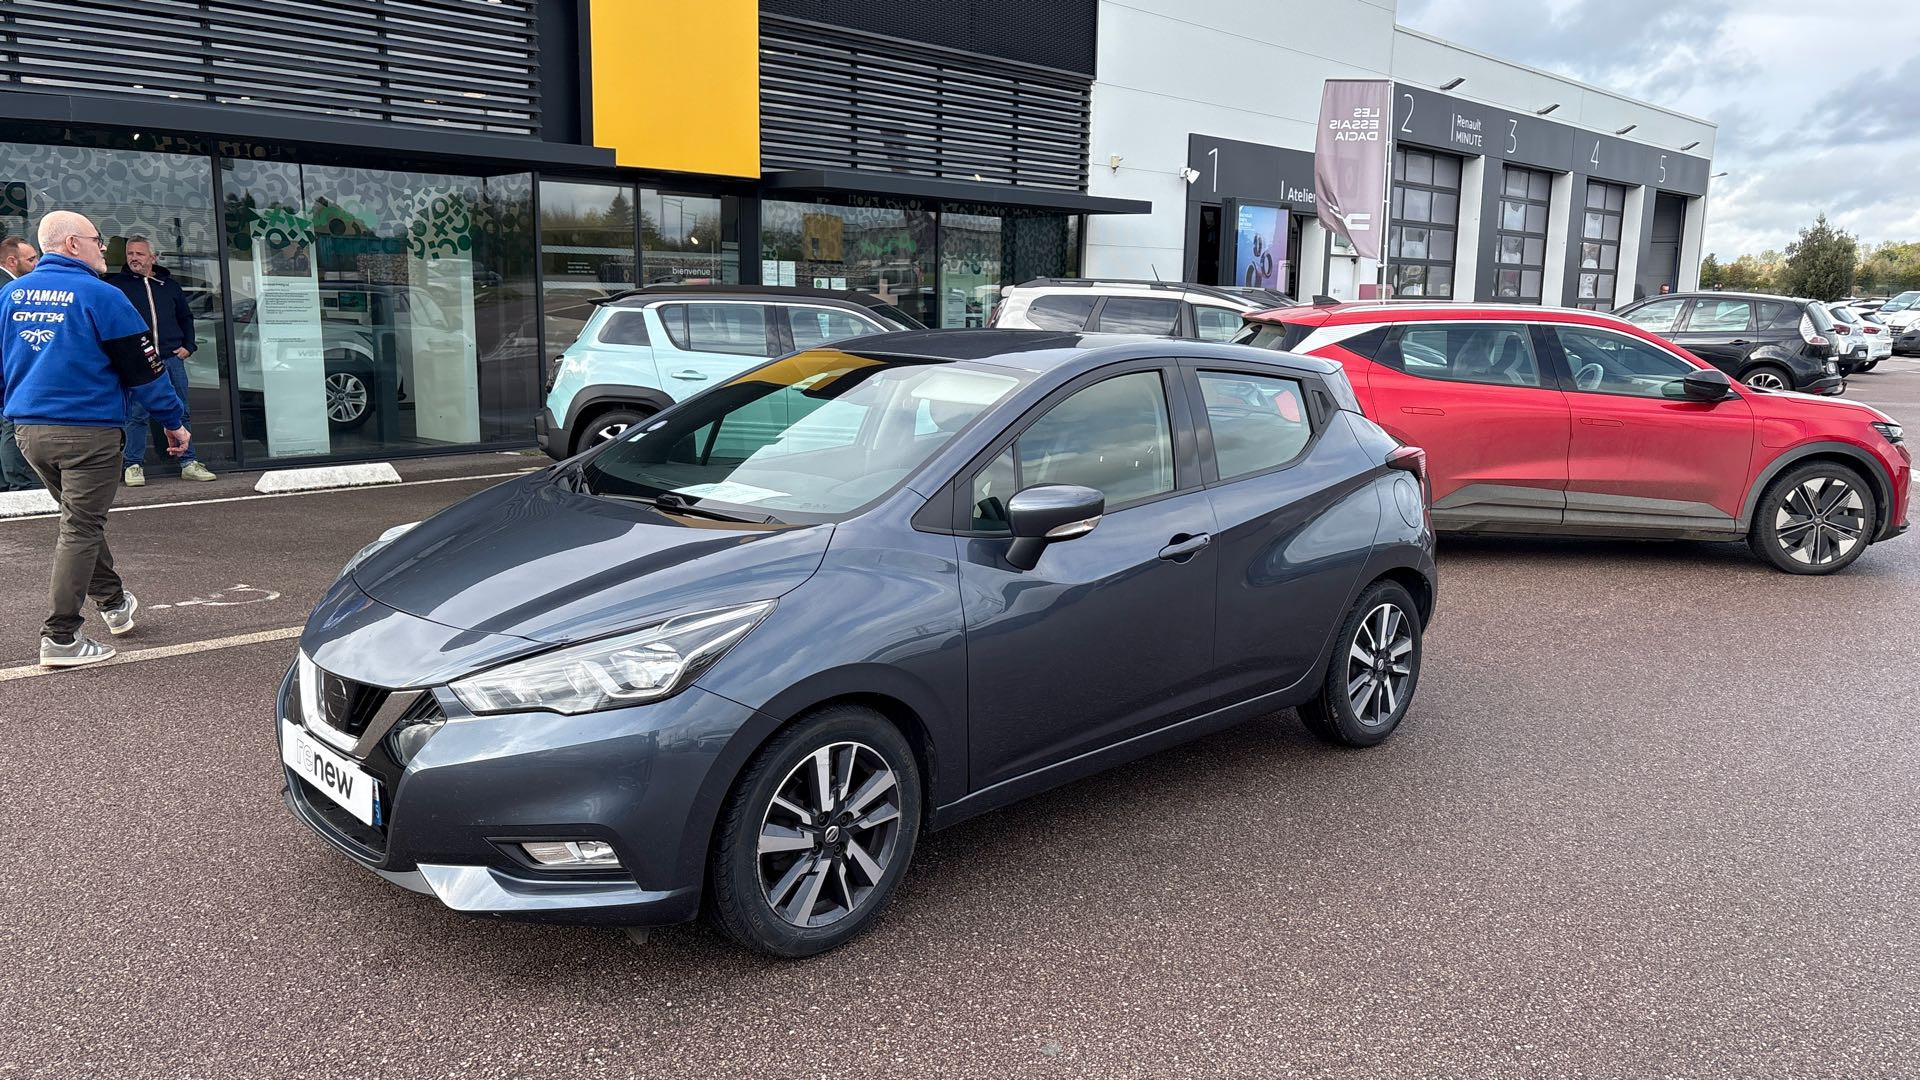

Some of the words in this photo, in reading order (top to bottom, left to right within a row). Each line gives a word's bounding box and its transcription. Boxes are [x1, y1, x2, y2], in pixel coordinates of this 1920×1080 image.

[1401, 94, 1414, 133] 2
[1457, 114, 1482, 131] Renault
[1455, 131, 1483, 147] MINUTE
[1506, 119, 1517, 153] 3
[1590, 140, 1600, 170] 4
[1658, 155, 1668, 183] 5
[1208, 147, 1218, 193] 1
[672, 266, 711, 276] bienvenue
[26, 289, 75, 304] YAMAHA
[12, 311, 65, 323] GMT94
[296, 737, 354, 800] renew
